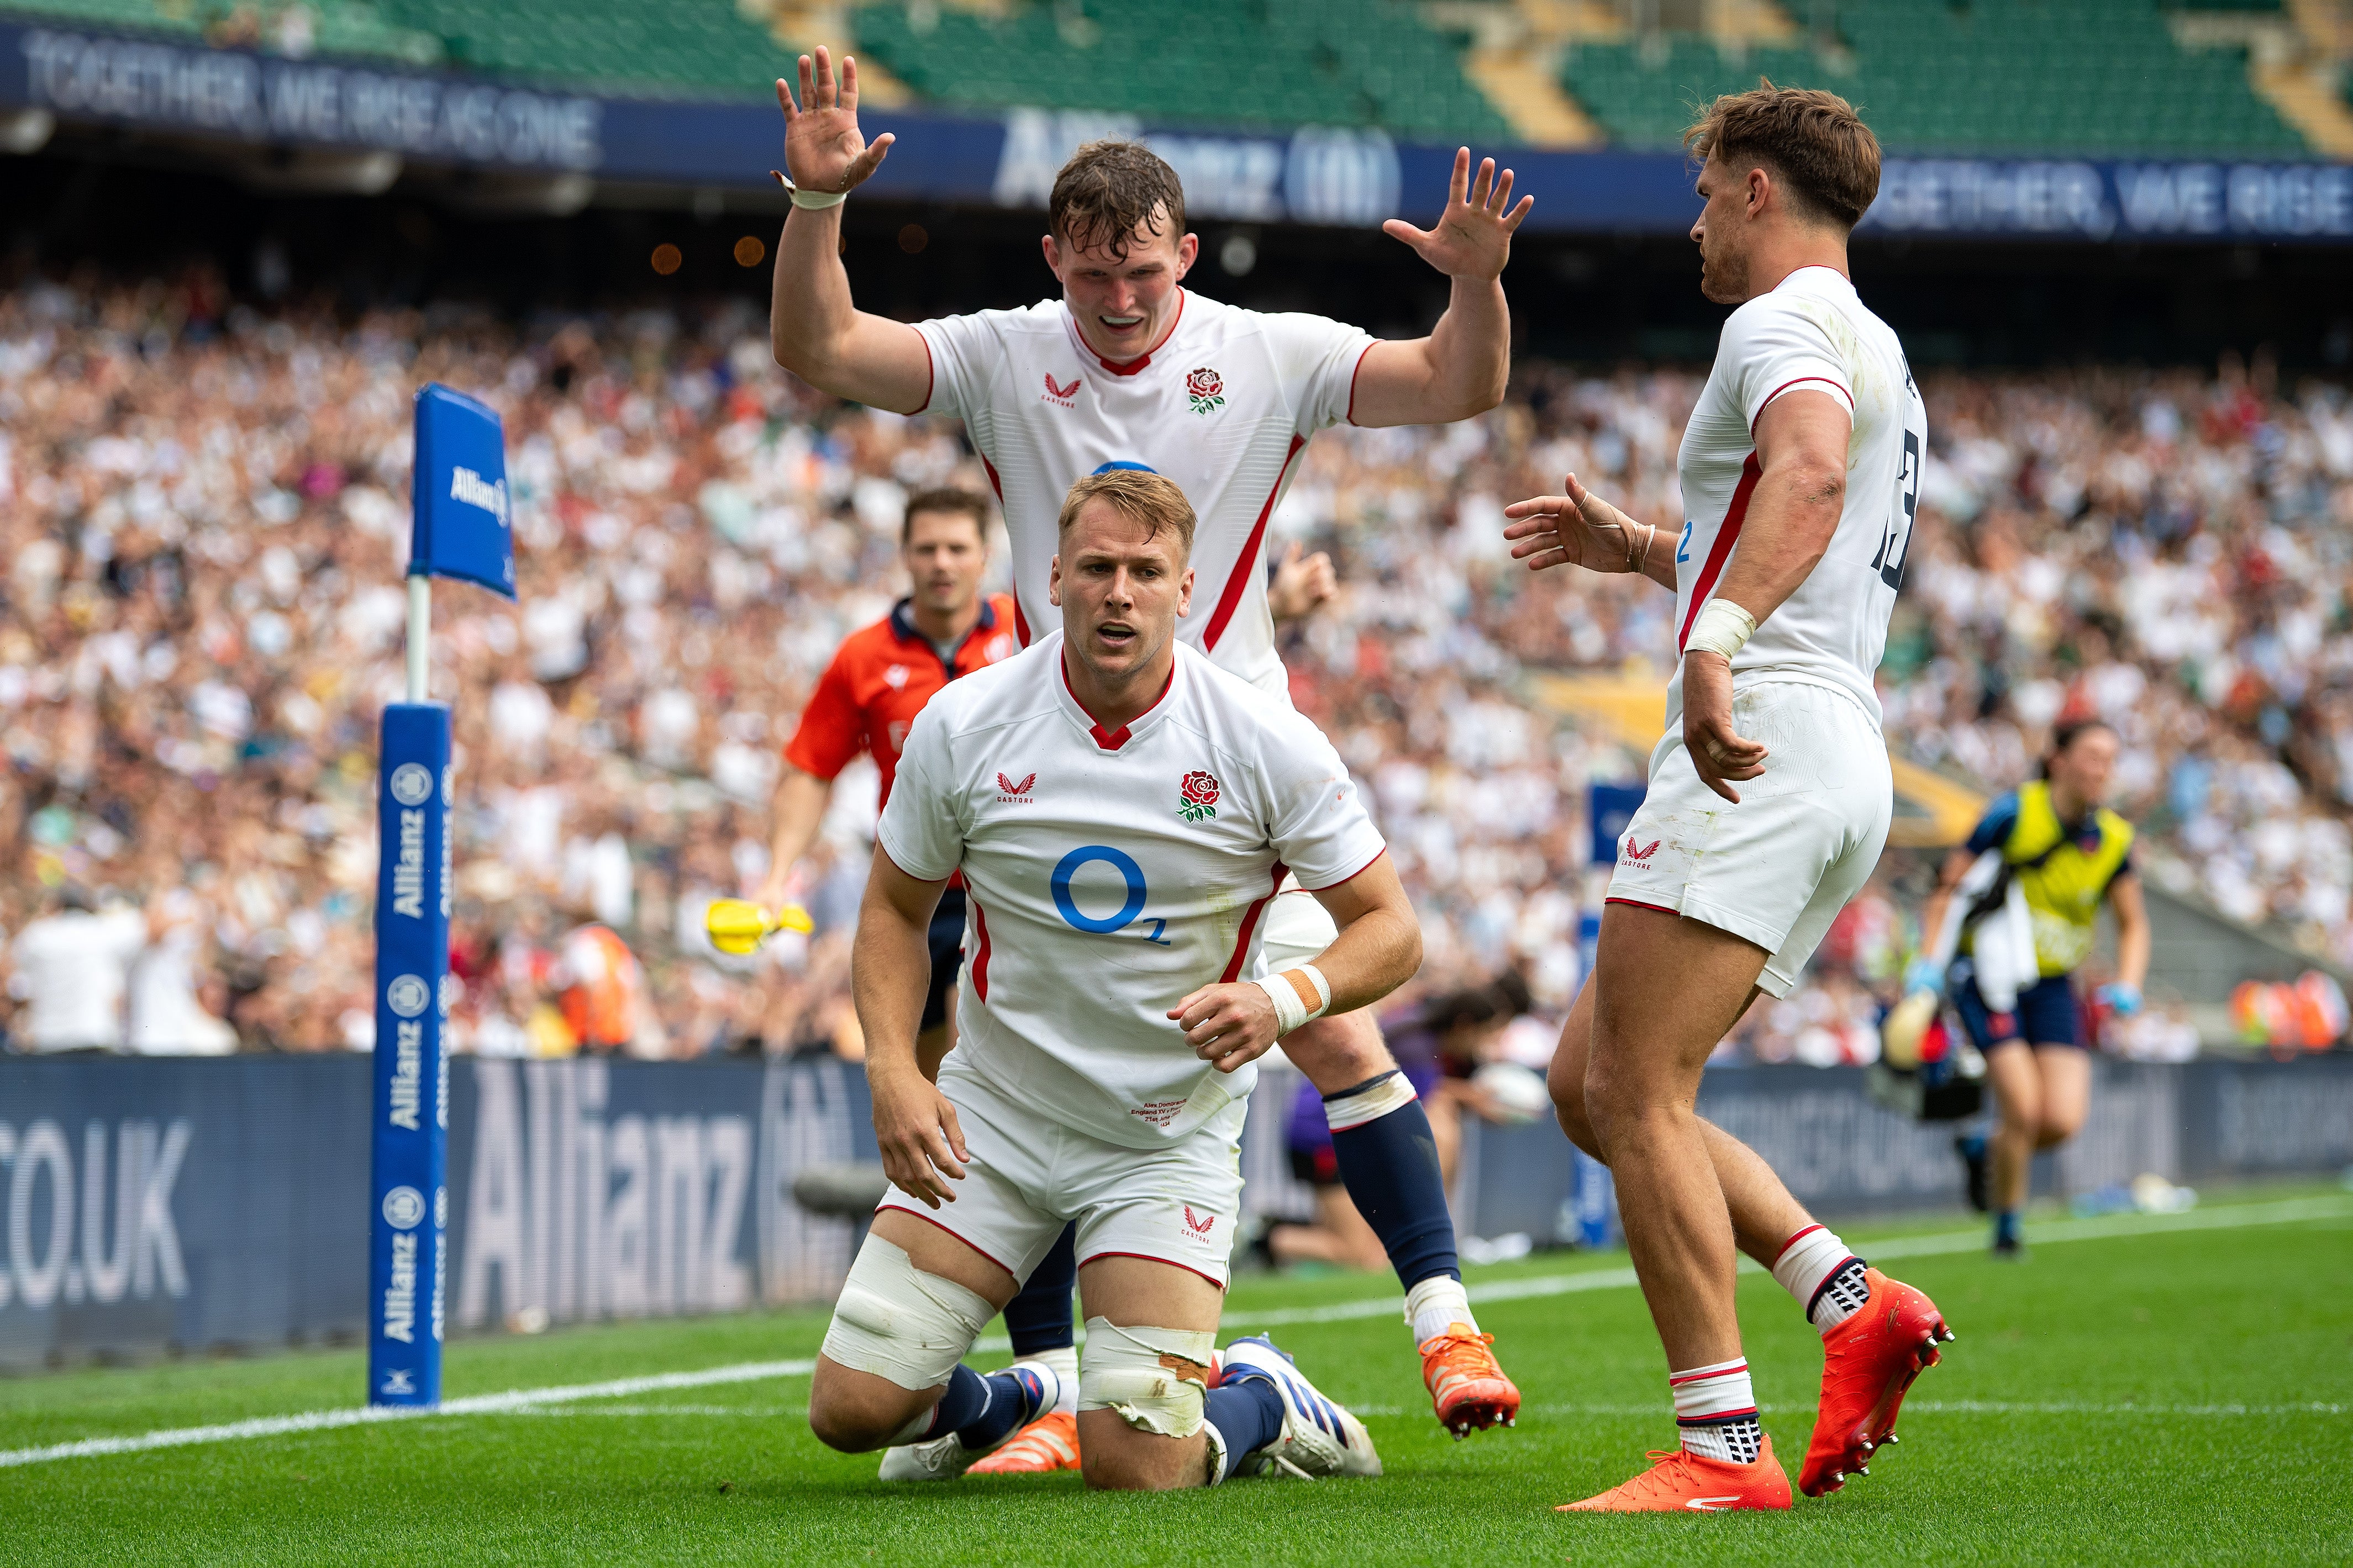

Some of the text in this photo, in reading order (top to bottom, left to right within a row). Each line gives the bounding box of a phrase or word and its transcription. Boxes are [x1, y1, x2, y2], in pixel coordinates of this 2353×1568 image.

[271, 62, 341, 141] WE
[344, 70, 440, 152] RISE
[444, 83, 498, 160] AS
[1863, 159, 2117, 242] GETHER,
[2115, 163, 2221, 234] WE
[997, 796, 1034, 804] CASTORE
[393, 808, 425, 919] Allianz
[1621, 860, 1651, 870] CASTORE
[389, 1020, 422, 1131] Allianz
[0, 1118, 193, 1311] O.UK
[456, 1056, 752, 1328] Allianz
[1181, 1229, 1209, 1244] CASTORE
[383, 1232, 418, 1344] Allianz
